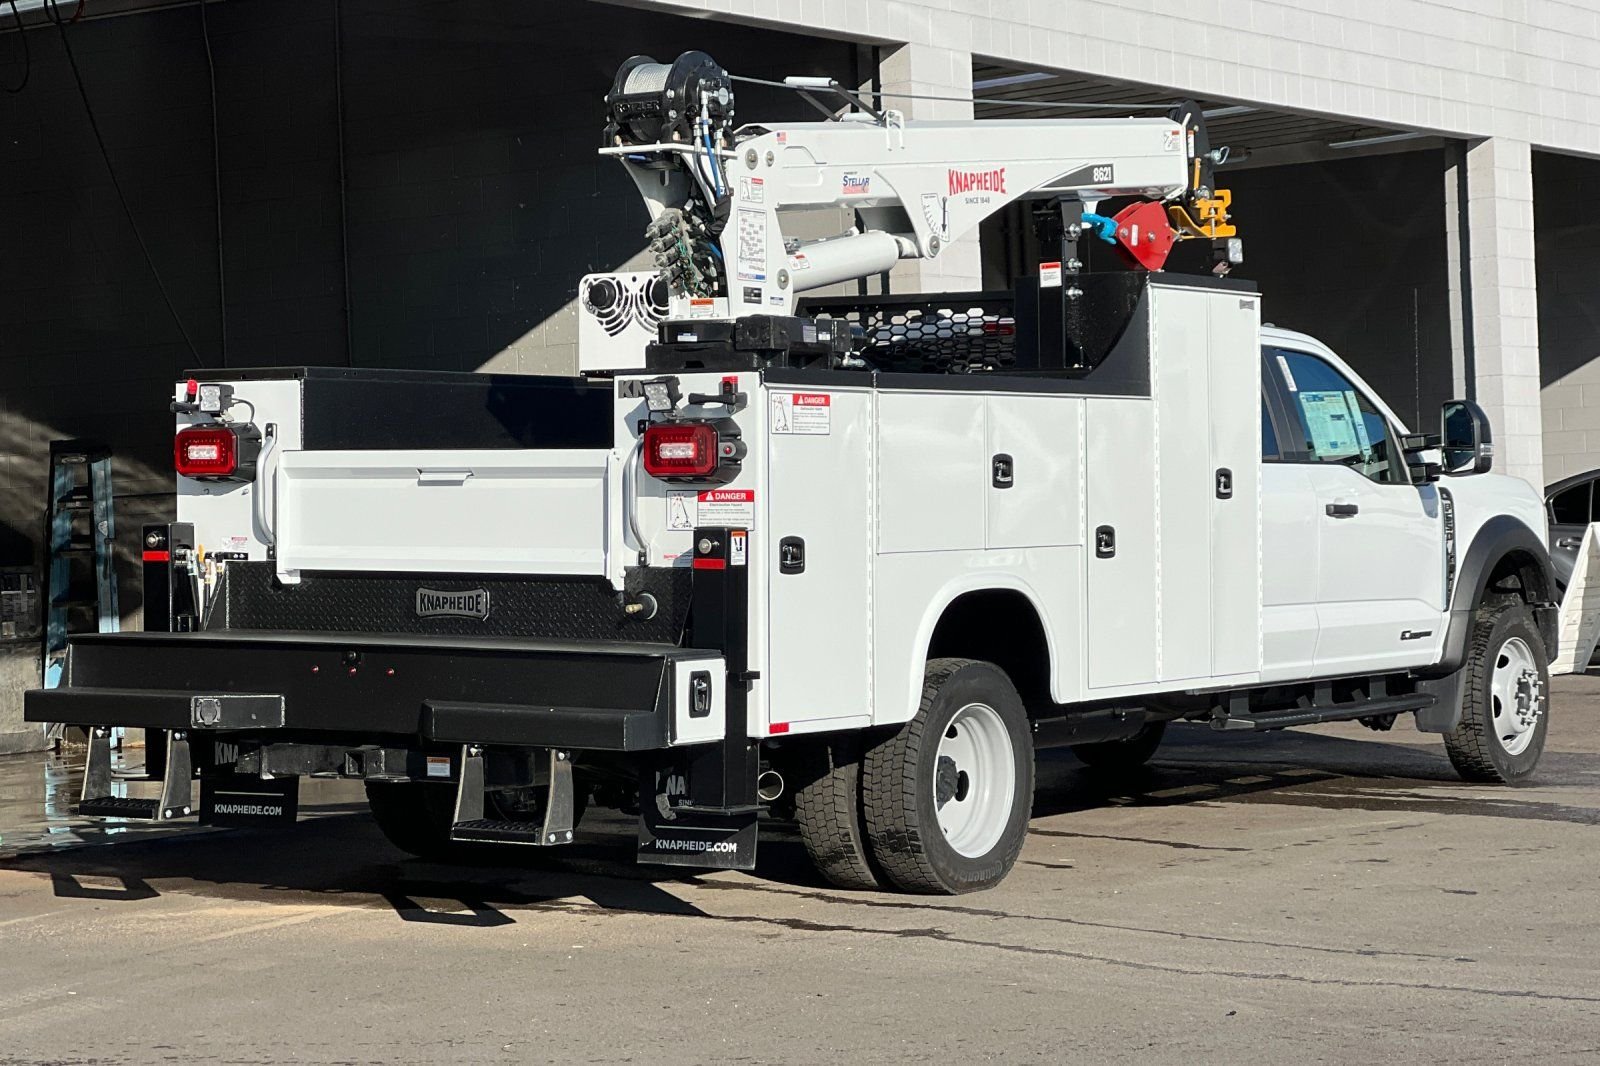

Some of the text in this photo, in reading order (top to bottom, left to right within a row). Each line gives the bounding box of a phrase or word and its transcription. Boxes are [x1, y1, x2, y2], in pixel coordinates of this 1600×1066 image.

[1093, 166, 1112, 182] 8621
[843, 175, 870, 187] STELLAR
[948, 168, 1006, 196] KNAPHEIDE
[803, 396, 825, 404] DANGER
[714, 492, 746, 500] DANGER
[420, 593, 482, 613] KNAPHEIDE
[214, 804, 282, 815] KNAPHEIDE.COM
[656, 839, 738, 852] KNAPHEIDE.COM
